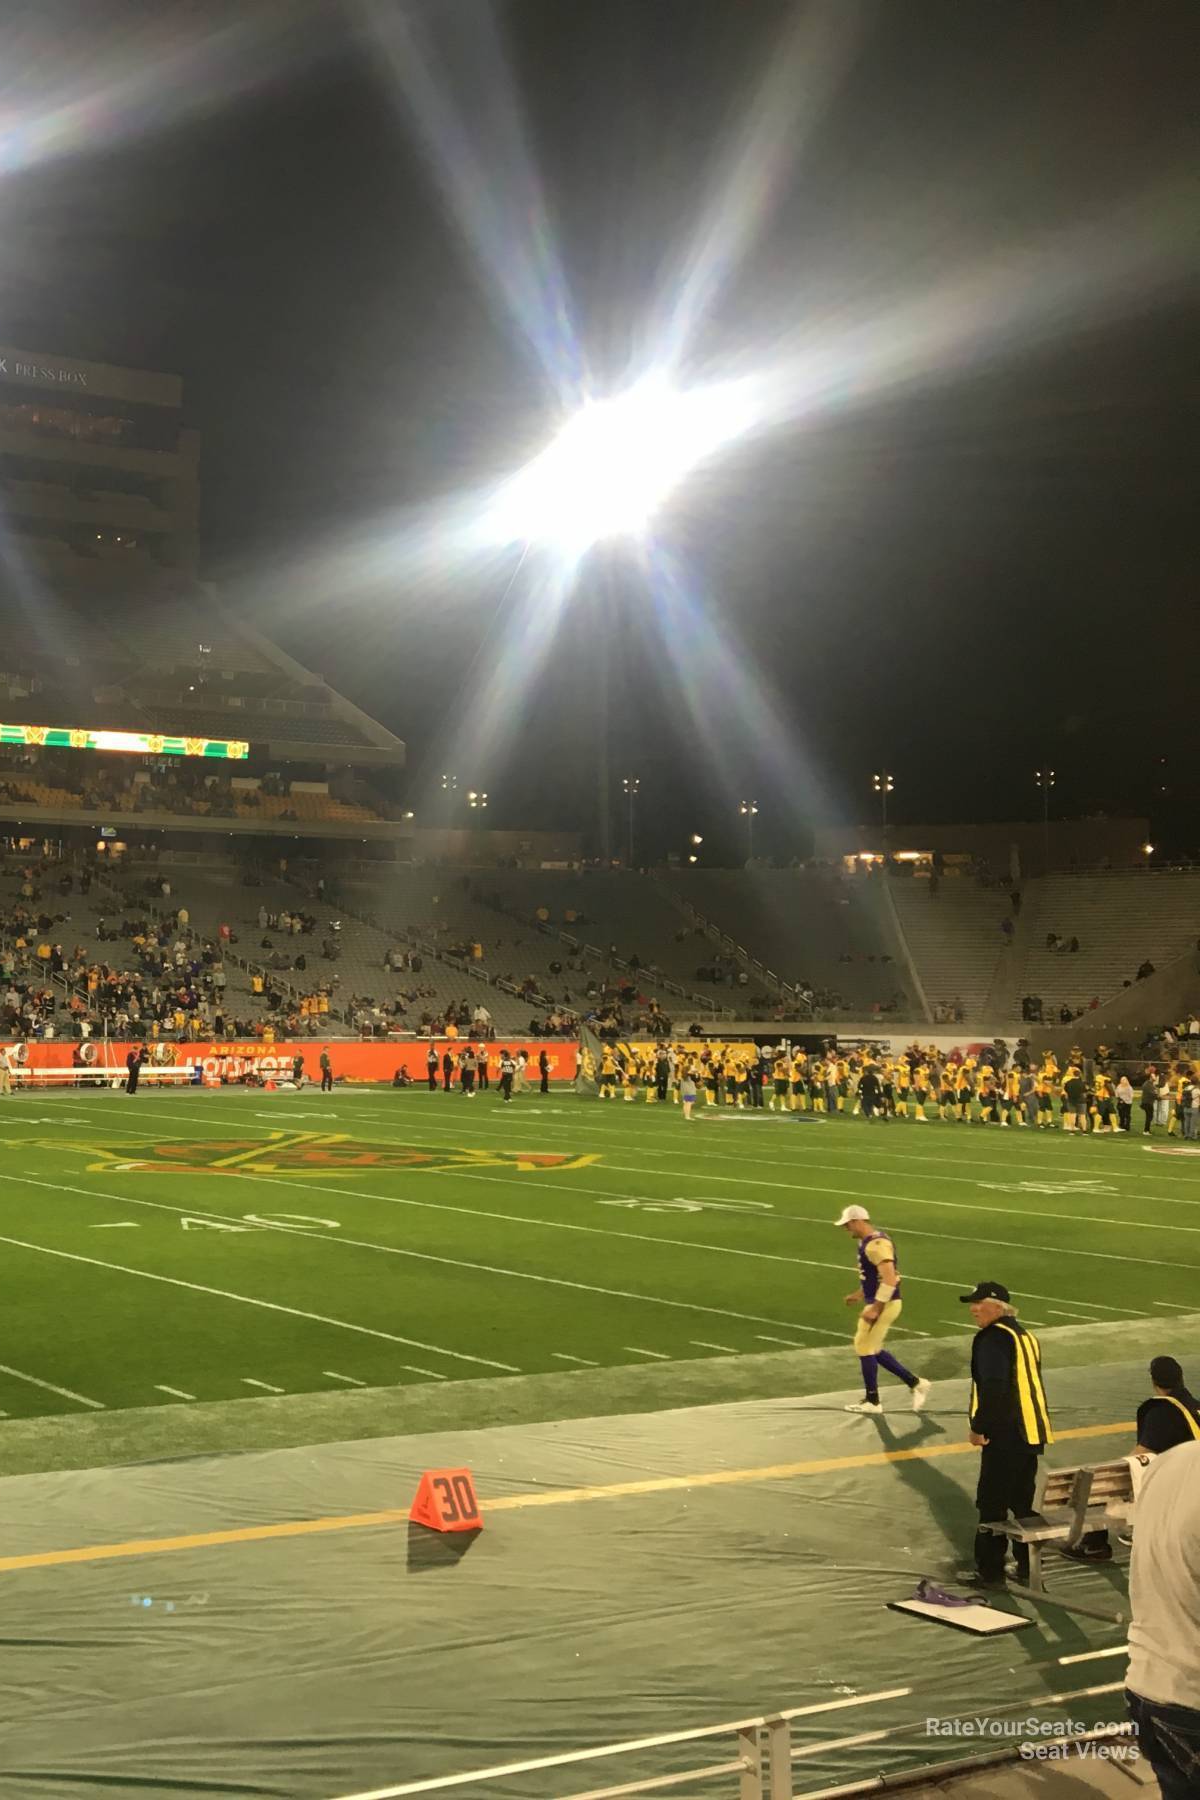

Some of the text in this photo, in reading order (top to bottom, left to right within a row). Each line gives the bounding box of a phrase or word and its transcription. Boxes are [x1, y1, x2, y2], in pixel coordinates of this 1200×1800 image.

[14, 362, 55, 382] PRESS
[58, 371, 88, 387] BOX
[209, 1046, 277, 1054] ARIZONA
[432, 1475, 479, 1522] 30
